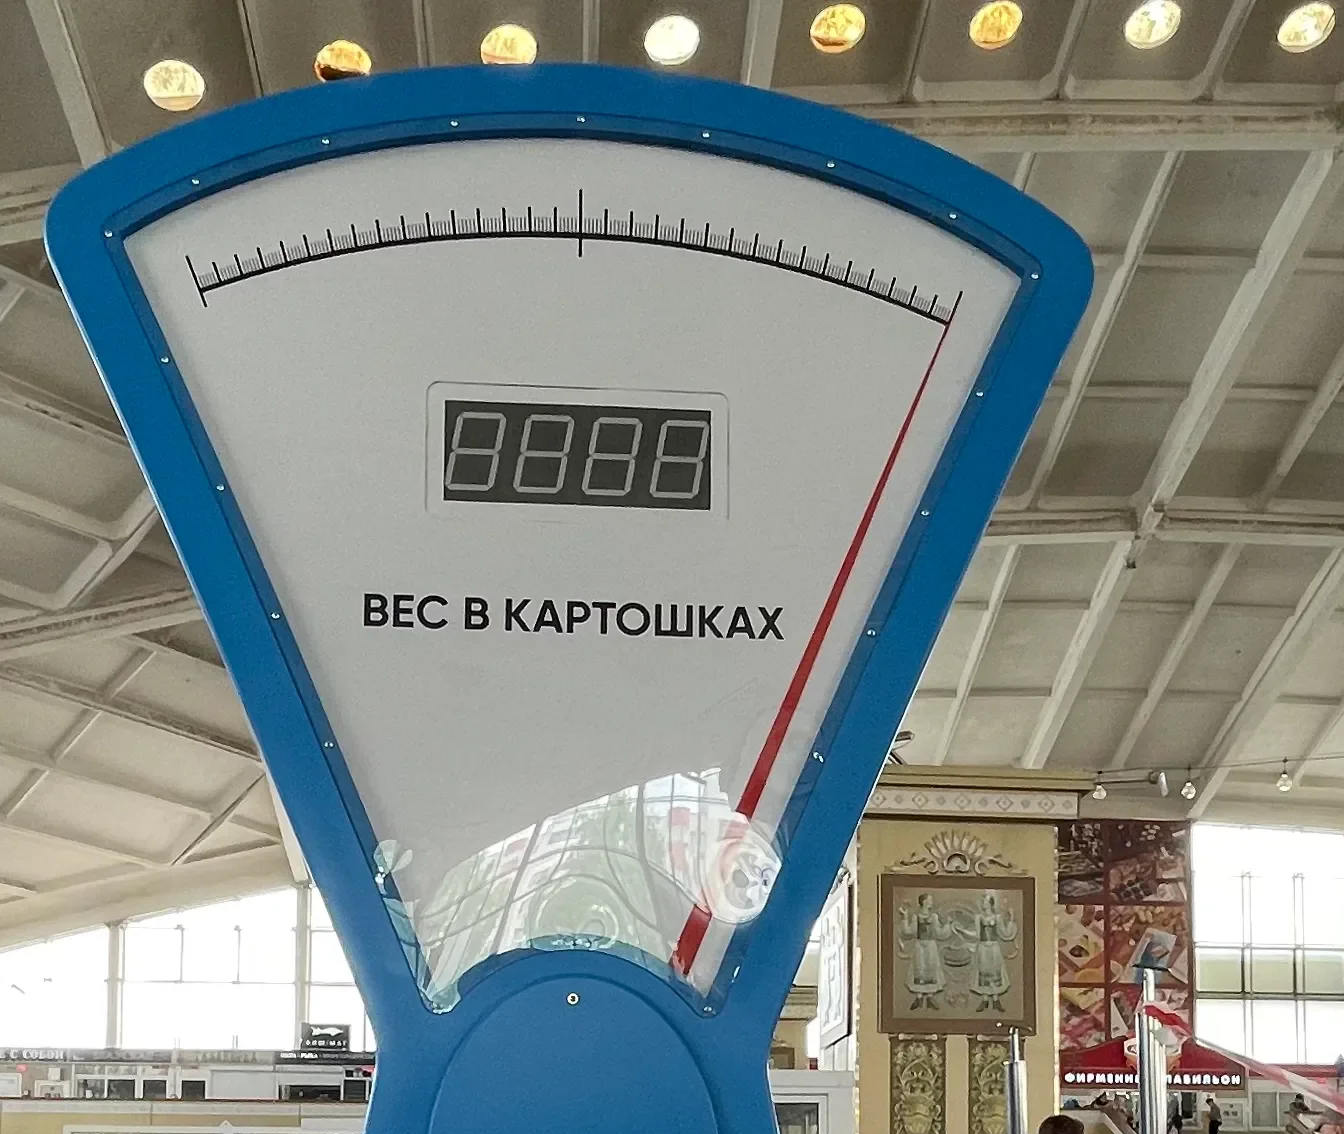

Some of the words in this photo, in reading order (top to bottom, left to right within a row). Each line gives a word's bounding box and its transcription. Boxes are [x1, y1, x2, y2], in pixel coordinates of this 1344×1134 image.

[362, 593, 449, 631] ВЕС
[465, 597, 490, 630] В
[504, 597, 785, 641] КАРТОШКАХ
